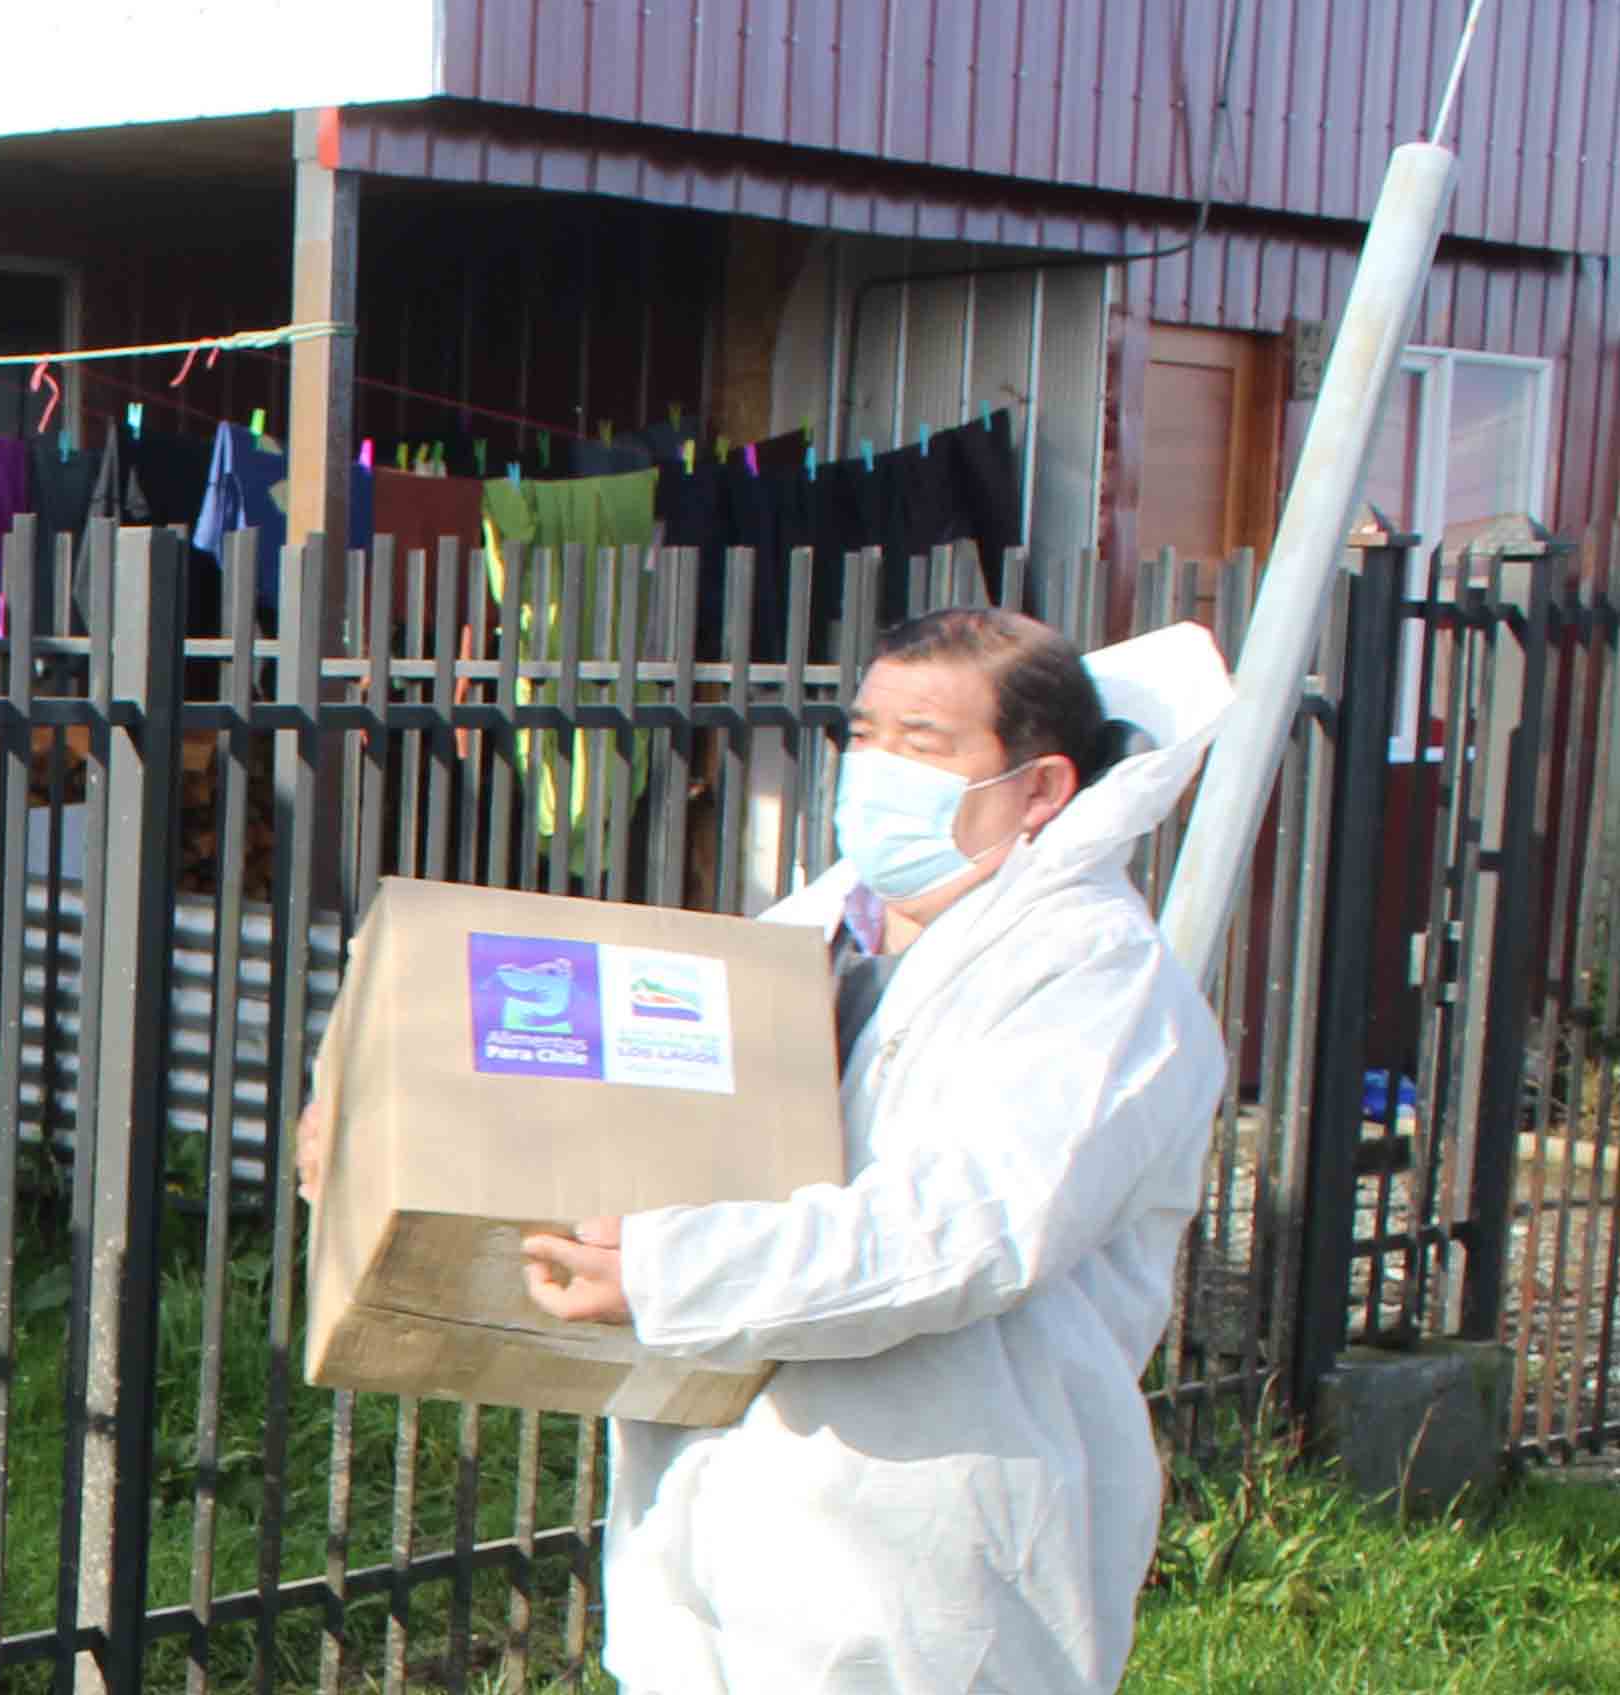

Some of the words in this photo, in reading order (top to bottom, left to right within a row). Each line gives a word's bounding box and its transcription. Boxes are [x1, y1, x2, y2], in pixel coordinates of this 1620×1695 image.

[486, 1030, 589, 1051] Alimentos
[484, 1044, 533, 1061] Para
[536, 1047, 589, 1065] Chile
[617, 1046, 652, 1058] LOS
